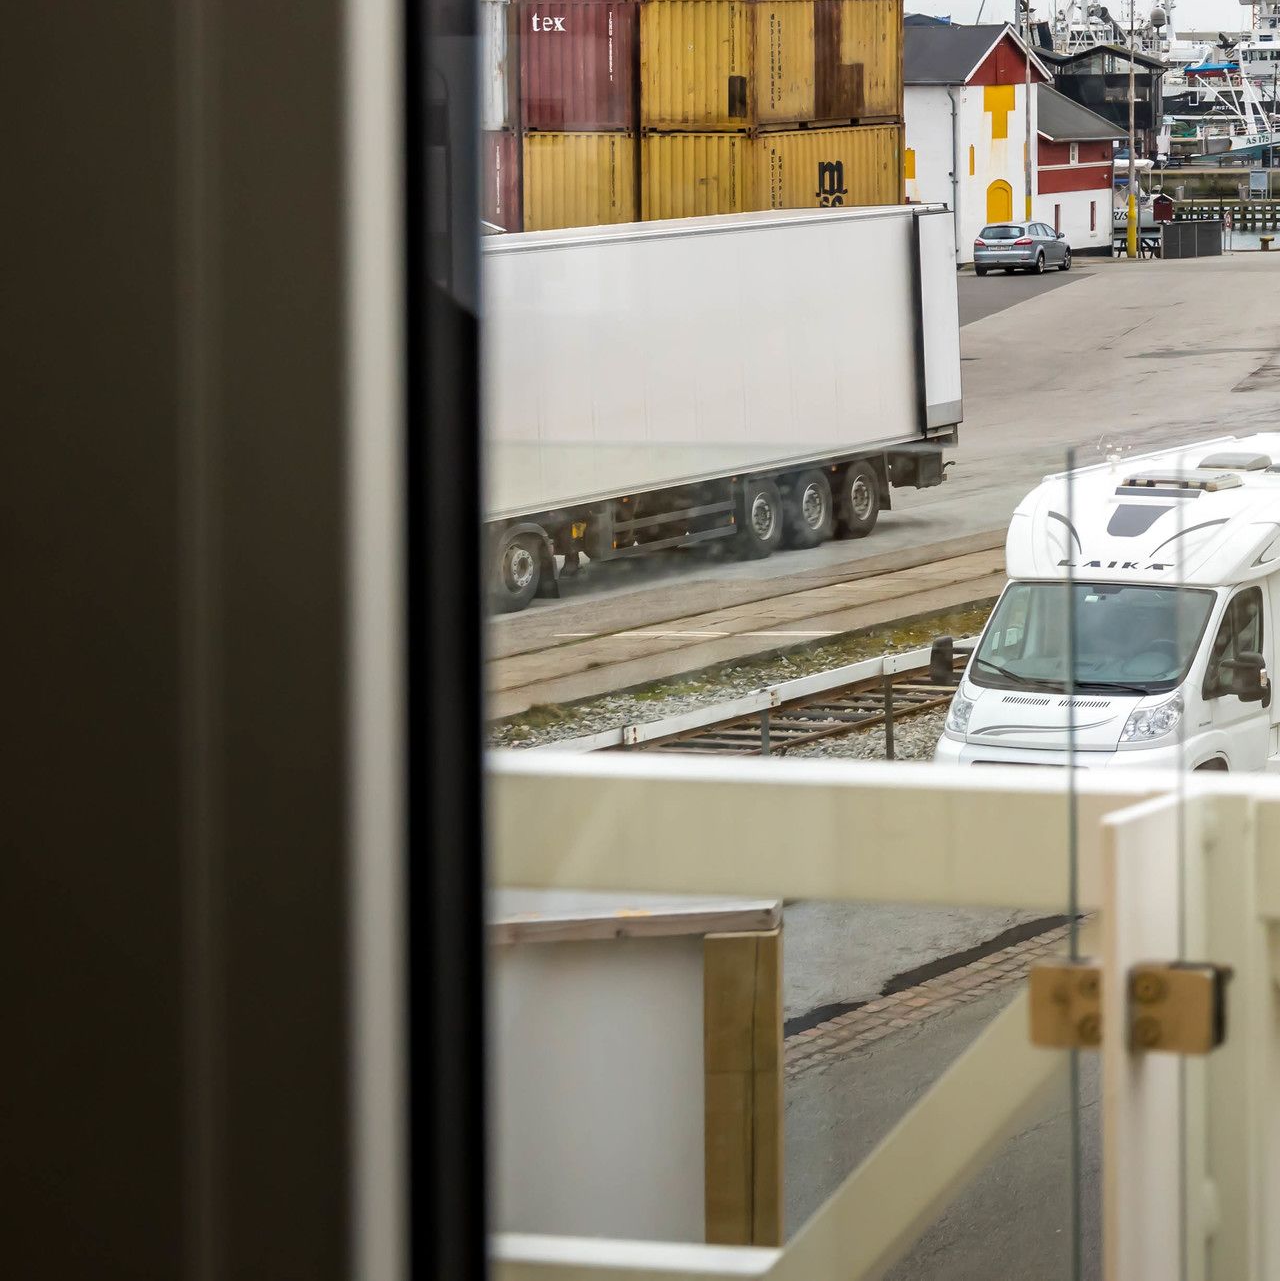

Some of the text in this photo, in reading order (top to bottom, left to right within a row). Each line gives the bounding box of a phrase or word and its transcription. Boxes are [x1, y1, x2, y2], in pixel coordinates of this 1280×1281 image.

[531, 12, 567, 32] tex
[1246, 135, 1270, 145] AS 175
[1057, 559, 1175, 570] LAIKA
